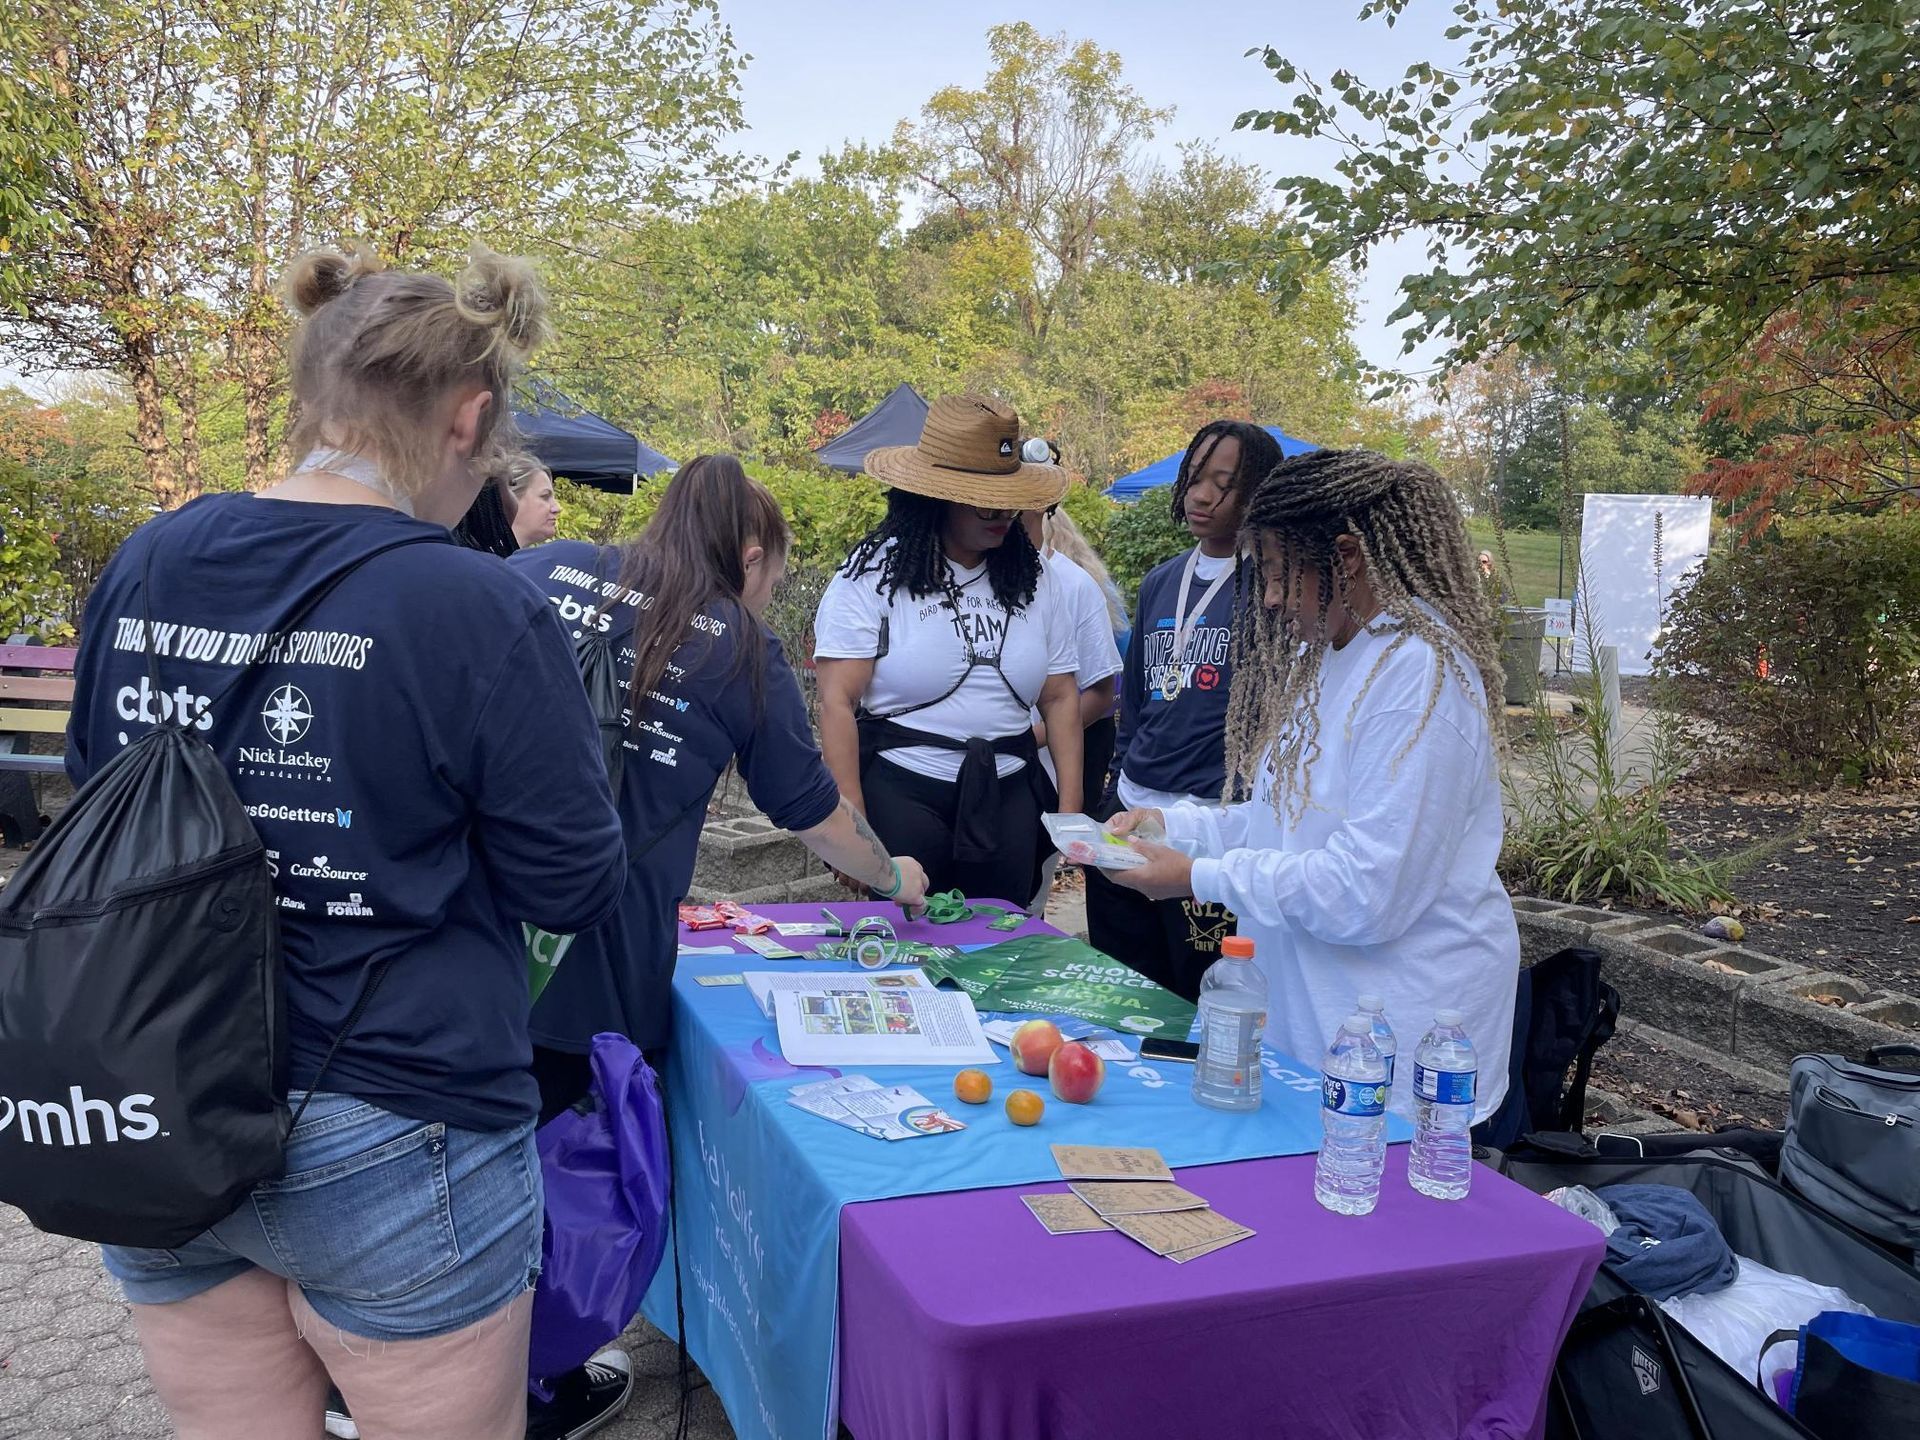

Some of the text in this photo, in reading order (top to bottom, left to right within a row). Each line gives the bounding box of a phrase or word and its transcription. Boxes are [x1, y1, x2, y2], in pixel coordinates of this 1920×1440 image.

[549, 565, 598, 590] THANK
[593, 581, 627, 599] OU
[621, 589, 644, 607] TO
[919, 603, 938, 622] BIRD
[966, 595, 982, 609] FOR
[986, 597, 1028, 624] RECOERY
[950, 612, 1004, 644] TEAM
[114, 617, 178, 656] THANK
[175, 625, 226, 662] YOU
[220, 632, 251, 665] TO
[283, 630, 374, 670] SPONSORS
[1143, 627, 1230, 670] OUTPCING
[116, 676, 213, 731] cbts
[638, 720, 684, 744] CareSource
[239, 747, 332, 774] Nick Lackey
[650, 751, 677, 767] FORUM
[238, 767, 332, 783] Foundation
[243, 802, 335, 824] sGoGetters
[290, 863, 368, 881] CareSource
[281, 896, 306, 911] Bank
[327, 906, 374, 917] FORUM
[1181, 899, 1237, 922] POLO
[1214, 928, 1228, 939] 67
[1194, 939, 1215, 952] CREW
[1042, 968, 1163, 991] SCIENCE.
[1065, 963, 1148, 980] KNOW
[1324, 1075, 1341, 1090] Pure
[18, 1085, 160, 1147] mhs
